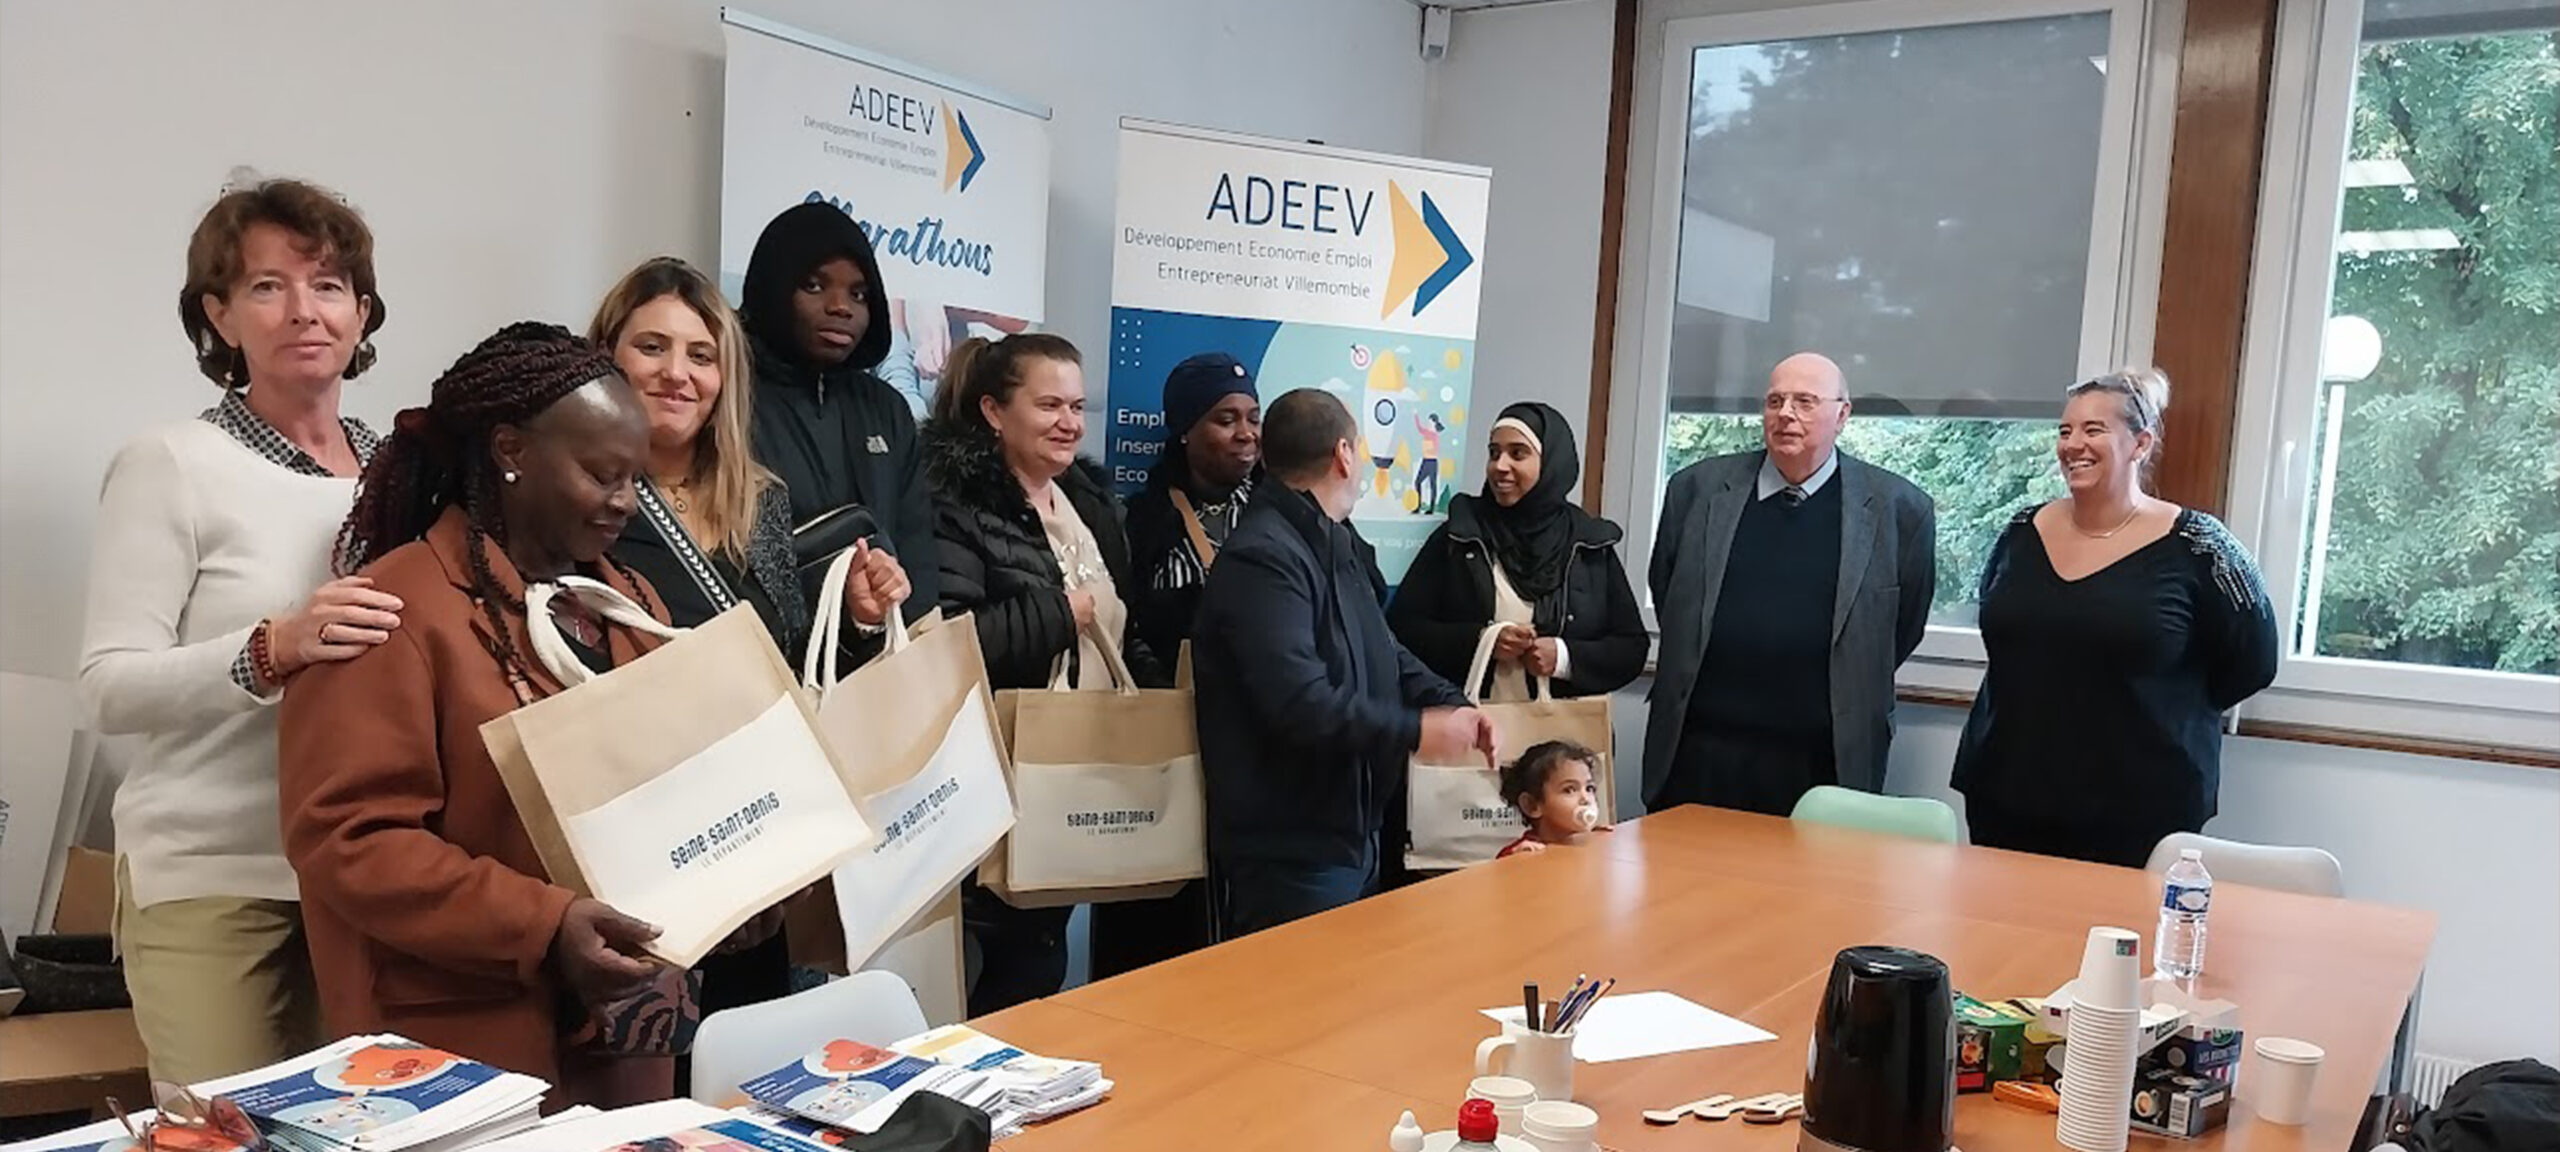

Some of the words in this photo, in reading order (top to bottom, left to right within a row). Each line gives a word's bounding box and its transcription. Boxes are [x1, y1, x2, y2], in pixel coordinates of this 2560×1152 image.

[849, 84, 935, 136] ADEEV
[1206, 173, 1374, 237] ADEEV
[1124, 227, 1242, 256] Développement
[1325, 248, 1373, 270] Emploi
[1157, 262, 1279, 290] Entrepreneuriat
[1117, 407, 1166, 429] Empl
[1115, 466, 1149, 483] Eco
